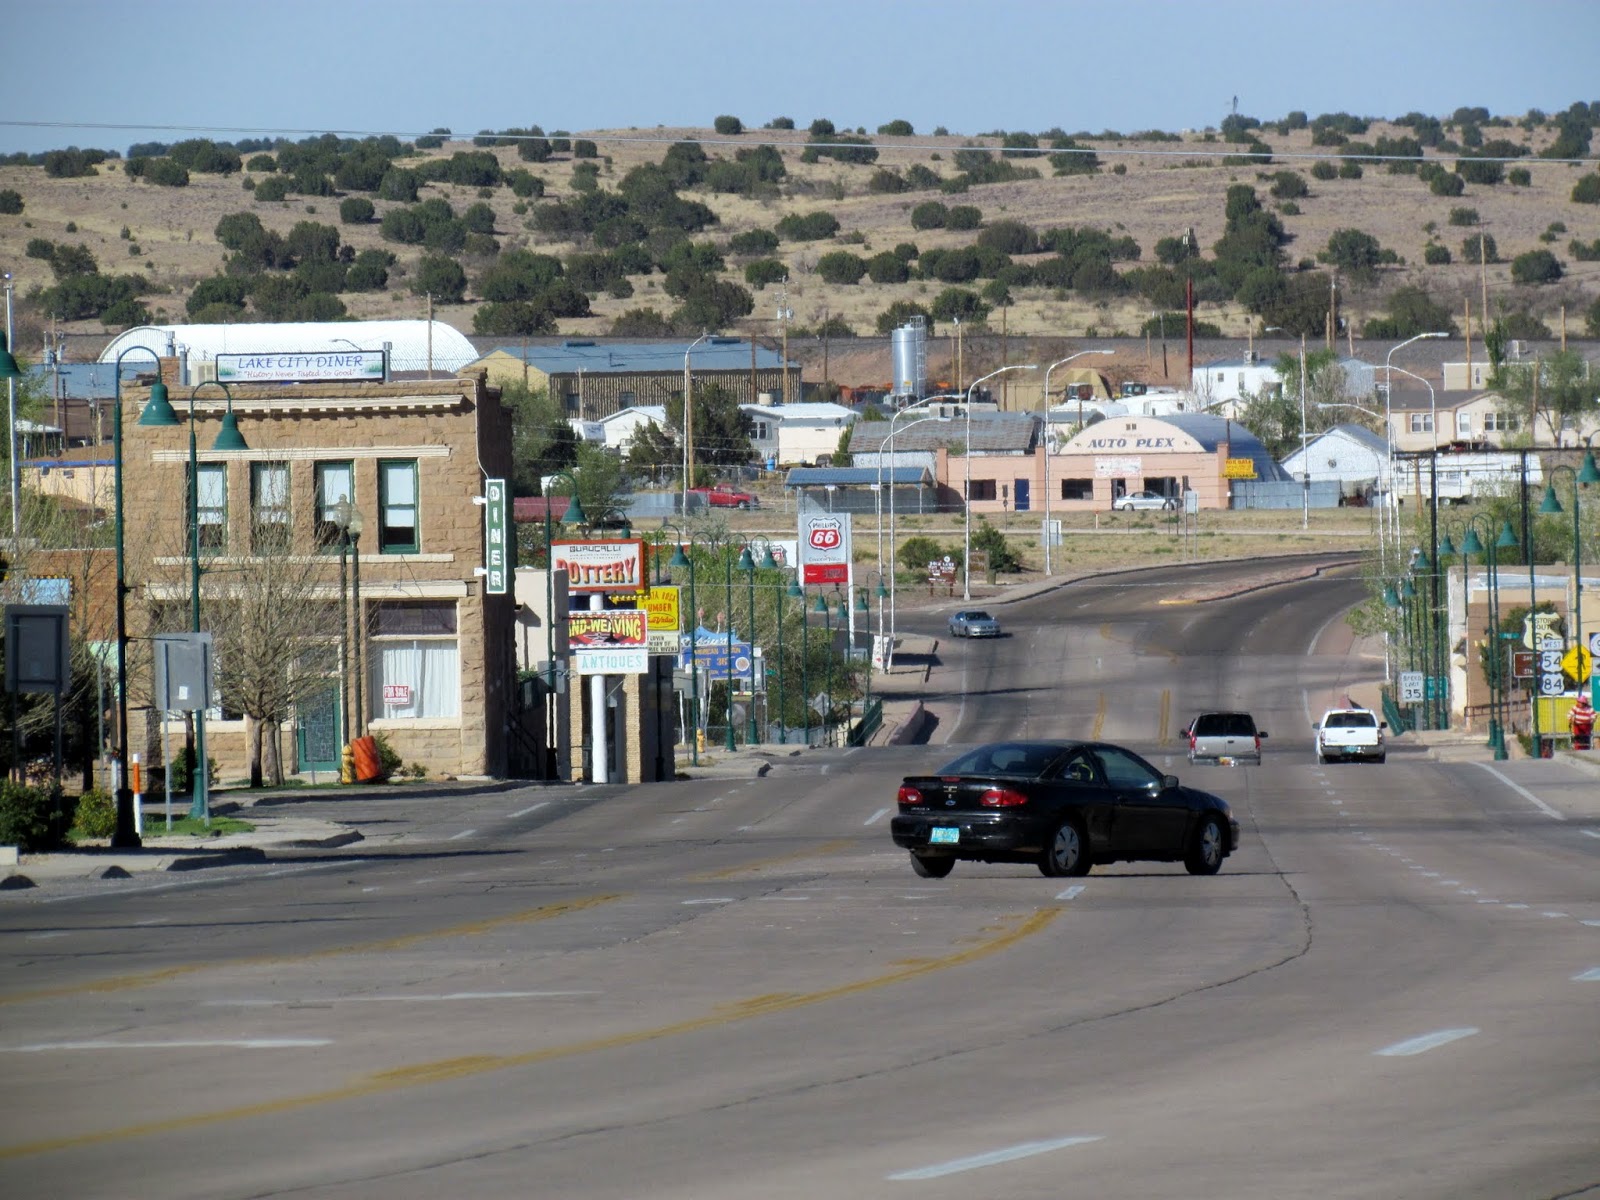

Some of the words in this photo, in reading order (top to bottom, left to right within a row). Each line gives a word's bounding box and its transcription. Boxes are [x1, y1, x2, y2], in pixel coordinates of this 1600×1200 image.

[238, 357, 273, 369] LAKE
[278, 356, 314, 369] CITY
[315, 355, 363, 368] DINER
[275, 370, 294, 378] Never
[323, 369, 332, 377] So
[1088, 438, 1127, 448] AUTO
[1136, 437, 1175, 448] PLEX
[489, 485, 502, 587] DINER
[813, 531, 836, 544] 66
[569, 618, 641, 640] ND-WEAVING
[581, 655, 642, 669] ANTIQUES
[1543, 655, 1562, 668] 54
[1543, 678, 1562, 690] 84
[384, 687, 394, 697] FOR
[395, 686, 408, 697] SALE
[1405, 688, 1421, 699] 35
